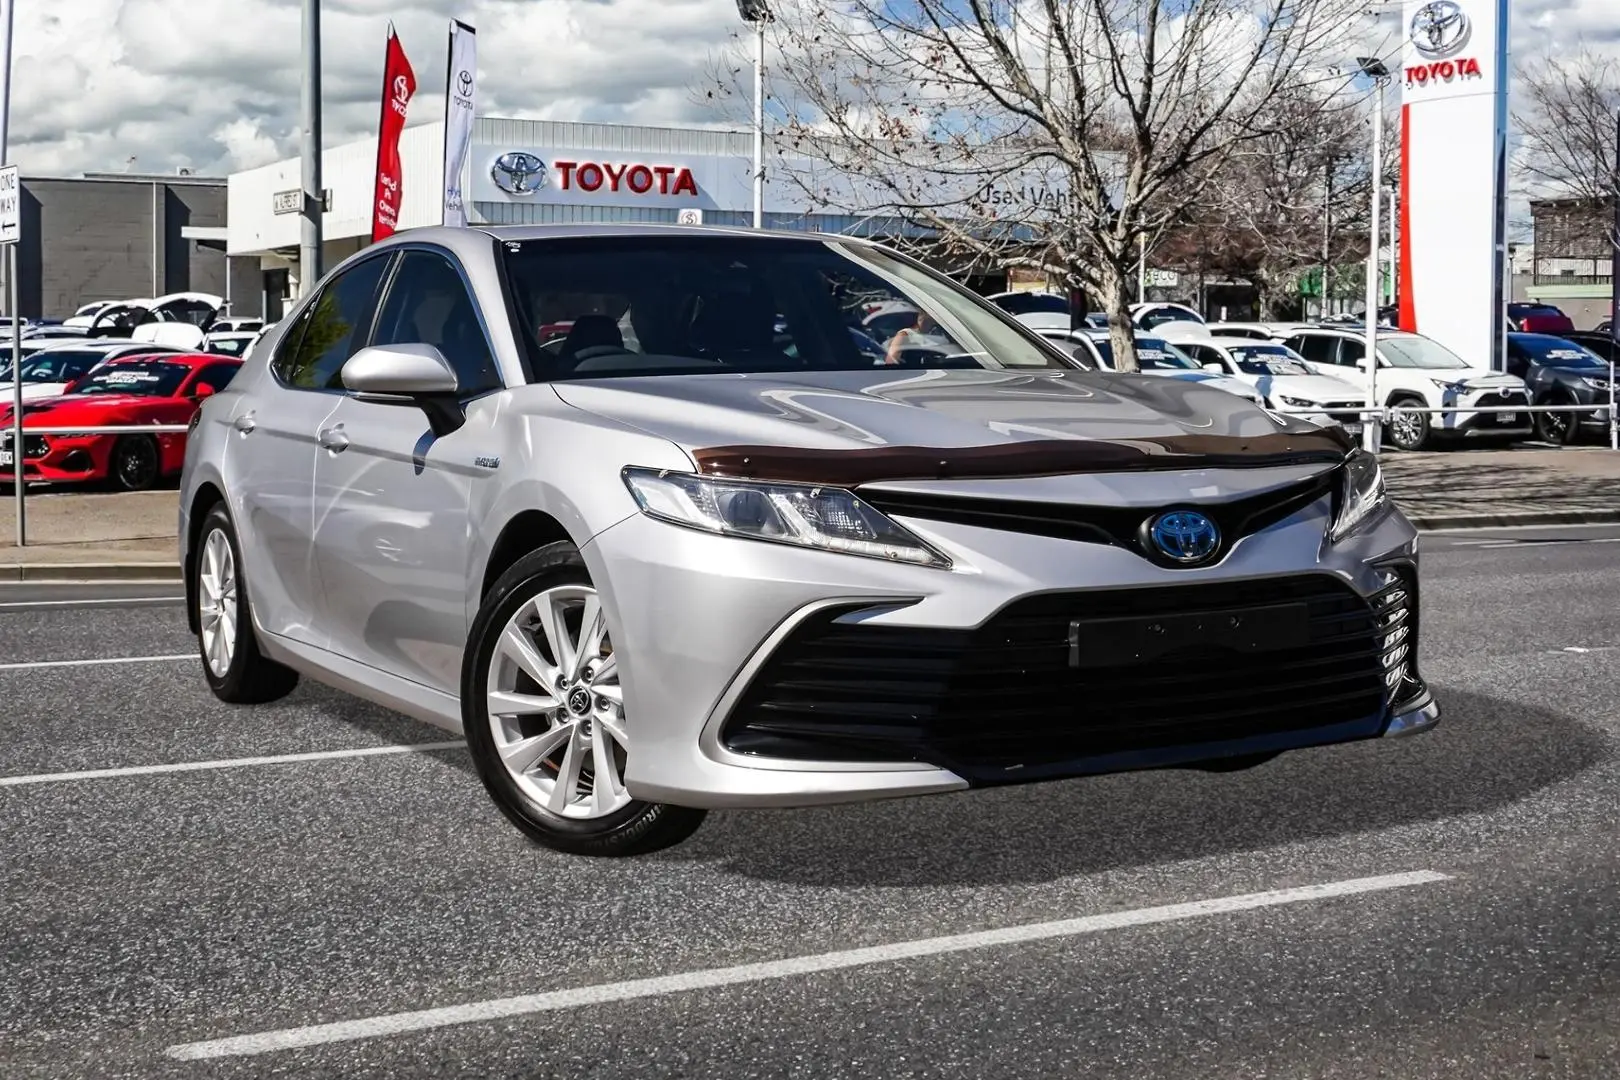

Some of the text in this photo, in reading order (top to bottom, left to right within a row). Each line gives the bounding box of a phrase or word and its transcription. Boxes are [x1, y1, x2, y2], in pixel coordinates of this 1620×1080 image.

[1404, 58, 1481, 83] TOYOTA
[1, 173, 15, 191] ONE
[555, 161, 698, 196] TOYOTA
[0, 196, 16, 214] WAY
